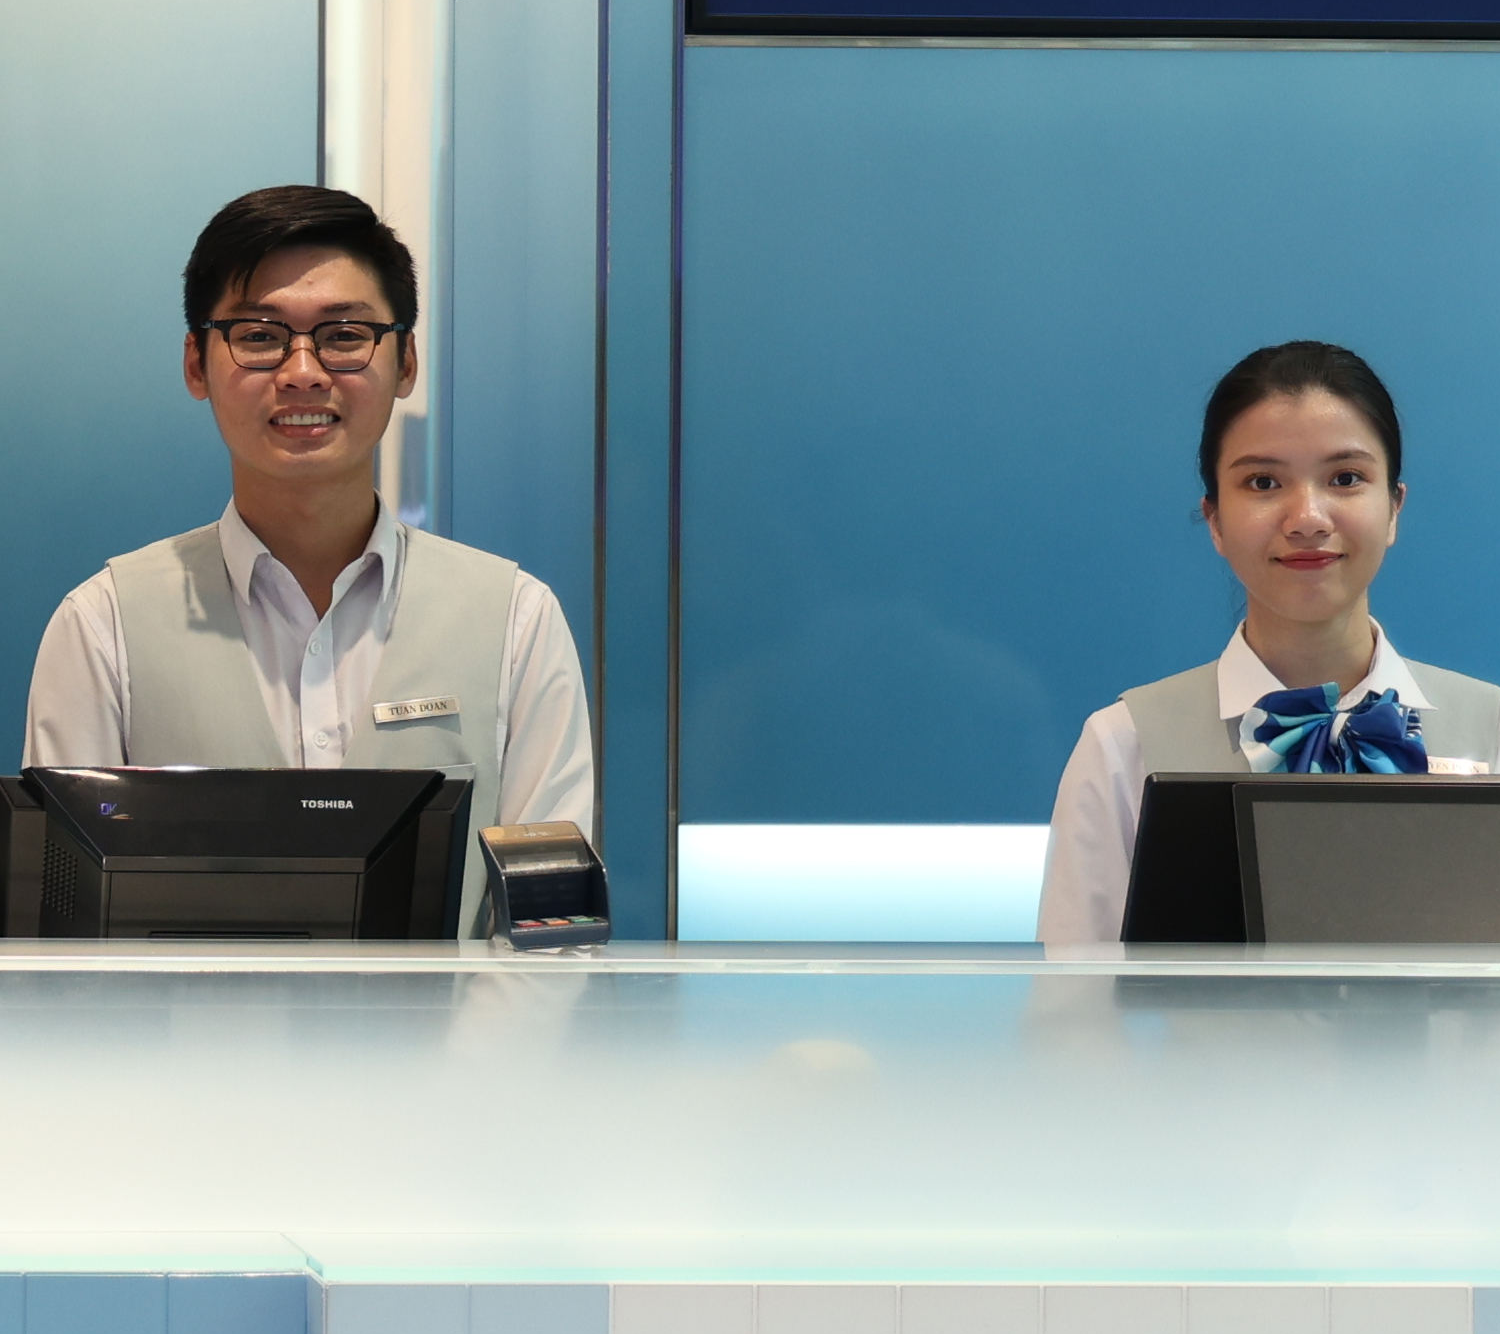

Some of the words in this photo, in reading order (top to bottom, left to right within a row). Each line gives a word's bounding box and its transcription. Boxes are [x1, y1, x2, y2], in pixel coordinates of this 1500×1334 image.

[388, 705, 417, 716] TUAN
[419, 701, 448, 713] DOAN
[300, 798, 354, 810] TOSHIBA
